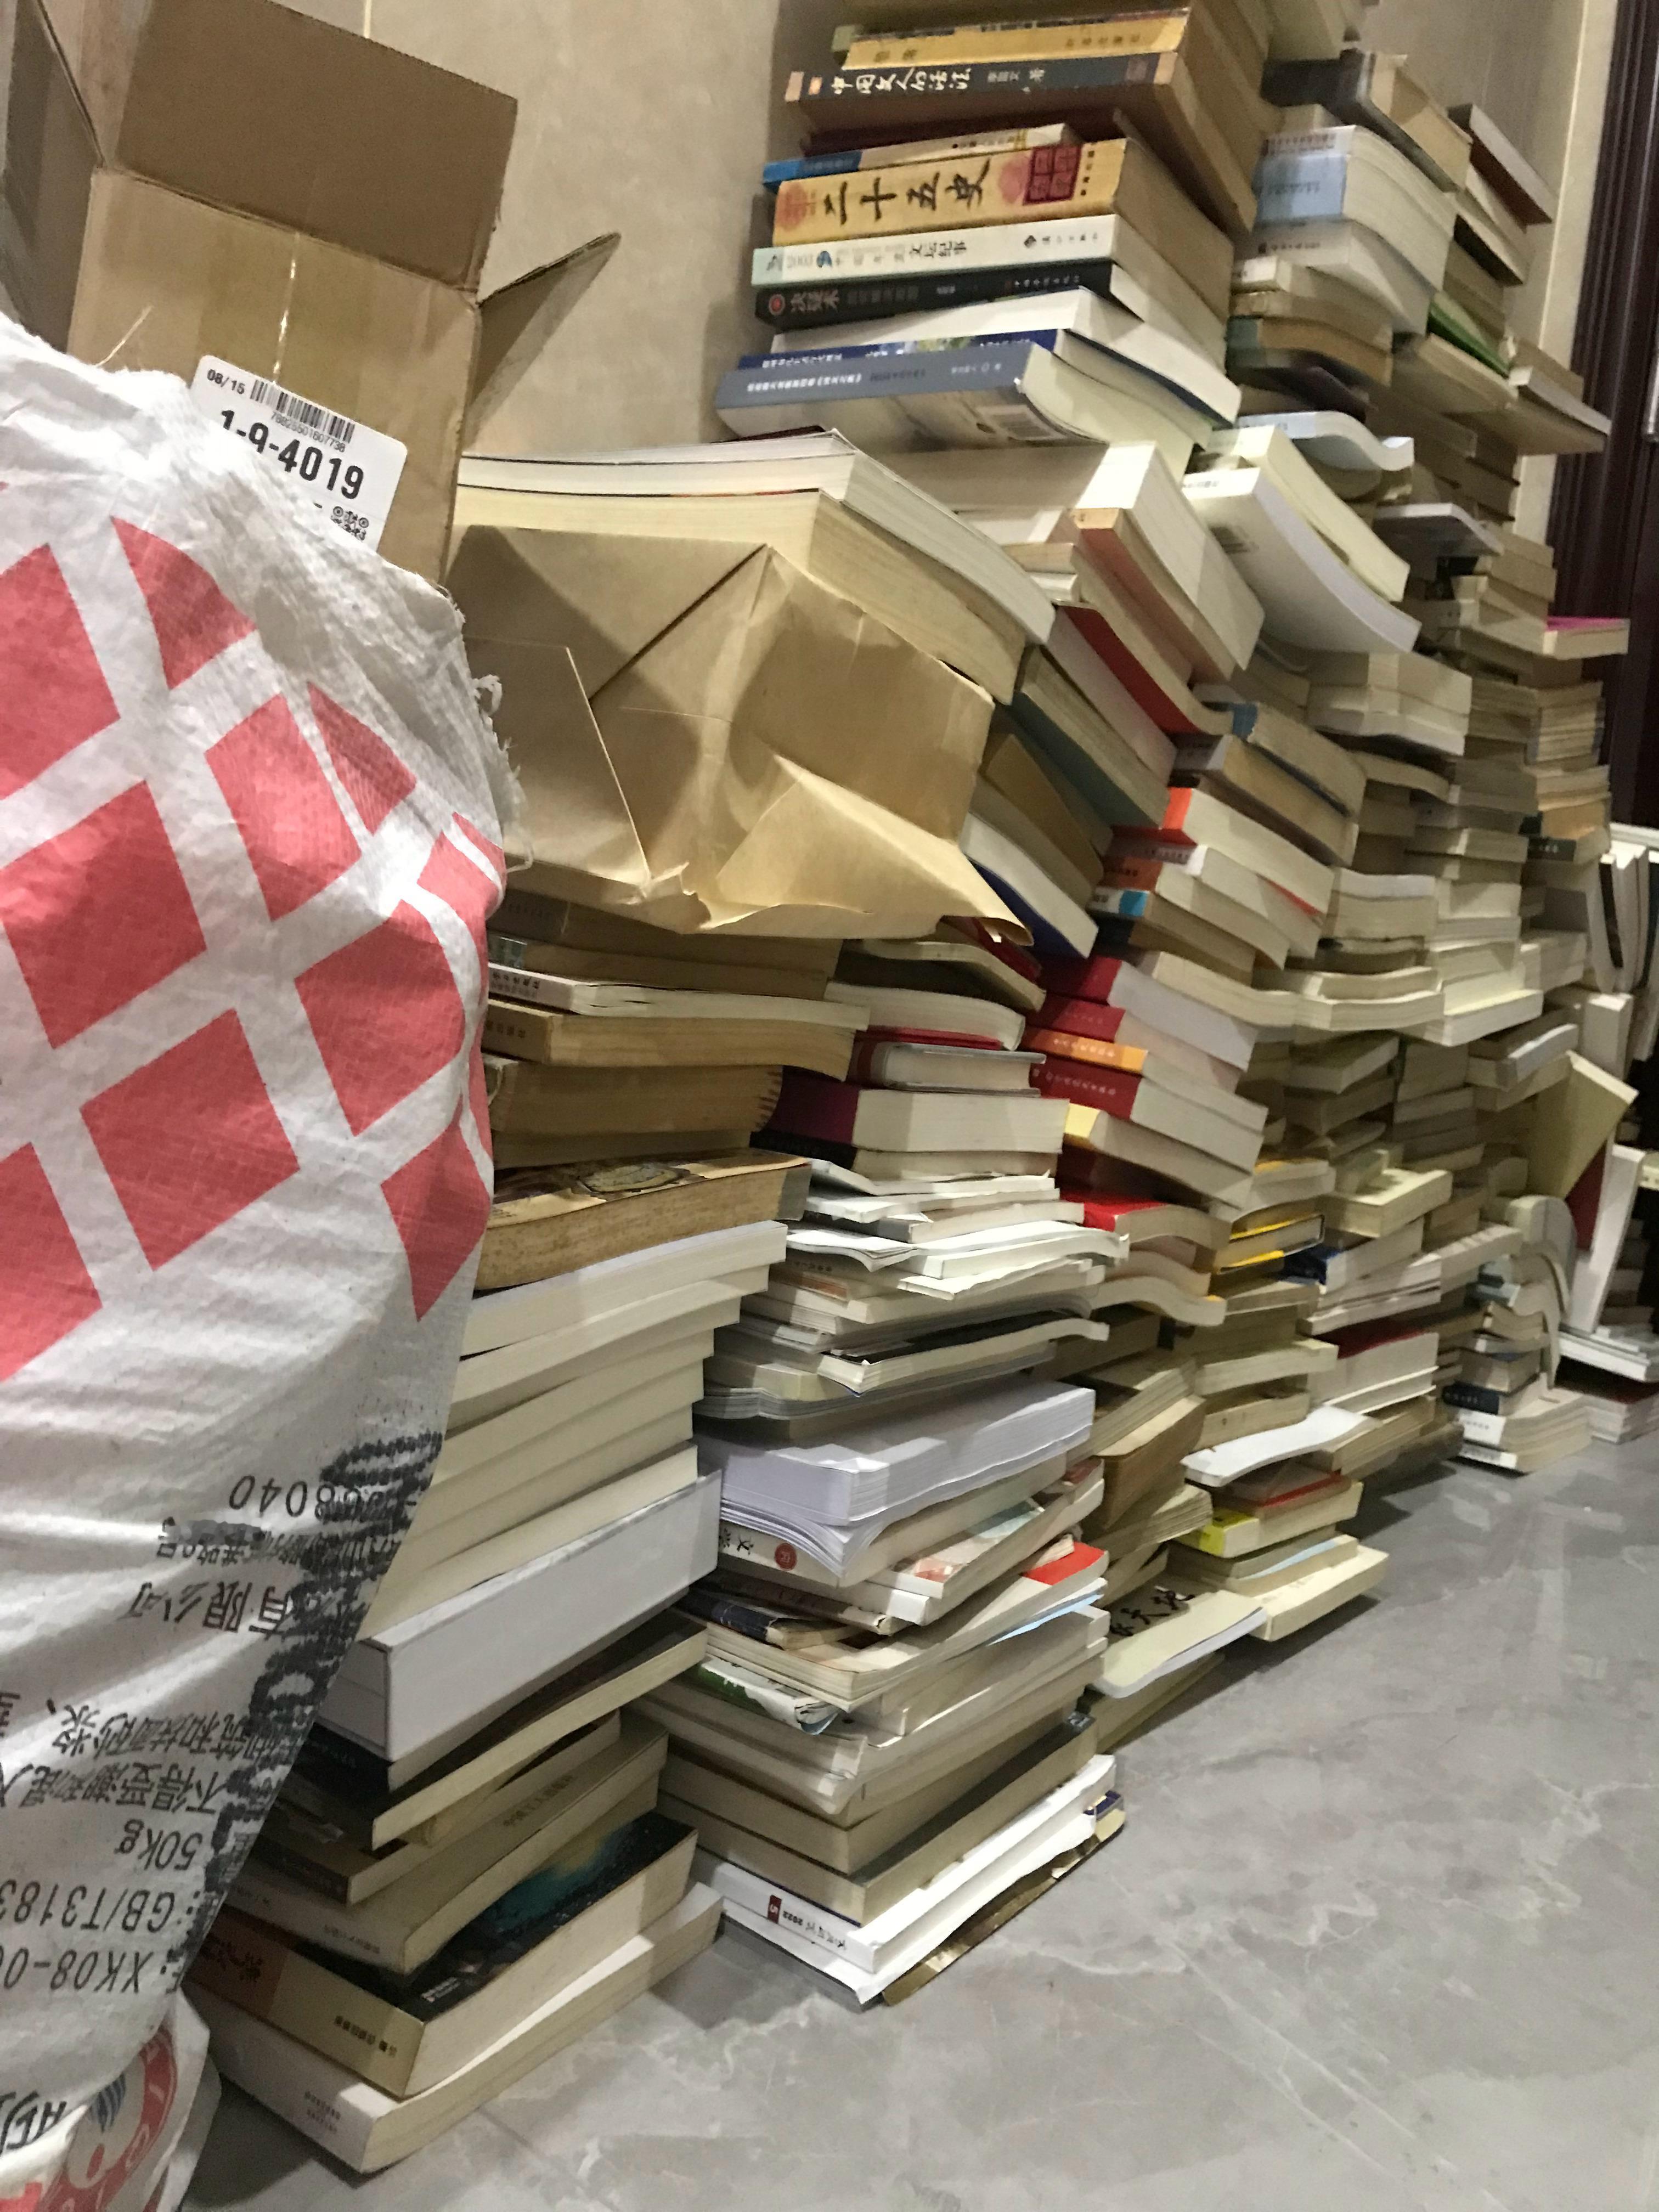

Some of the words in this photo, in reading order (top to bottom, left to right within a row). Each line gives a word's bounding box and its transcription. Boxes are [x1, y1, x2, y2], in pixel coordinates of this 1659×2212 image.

[823, 160, 991, 225] 二十五史
[207, 369, 245, 395] 08/15
[221, 409, 364, 500] 1-9-4019
[114, 1819, 204, 1871] 50kg
[0, 1948, 153, 1994] XK08-0
